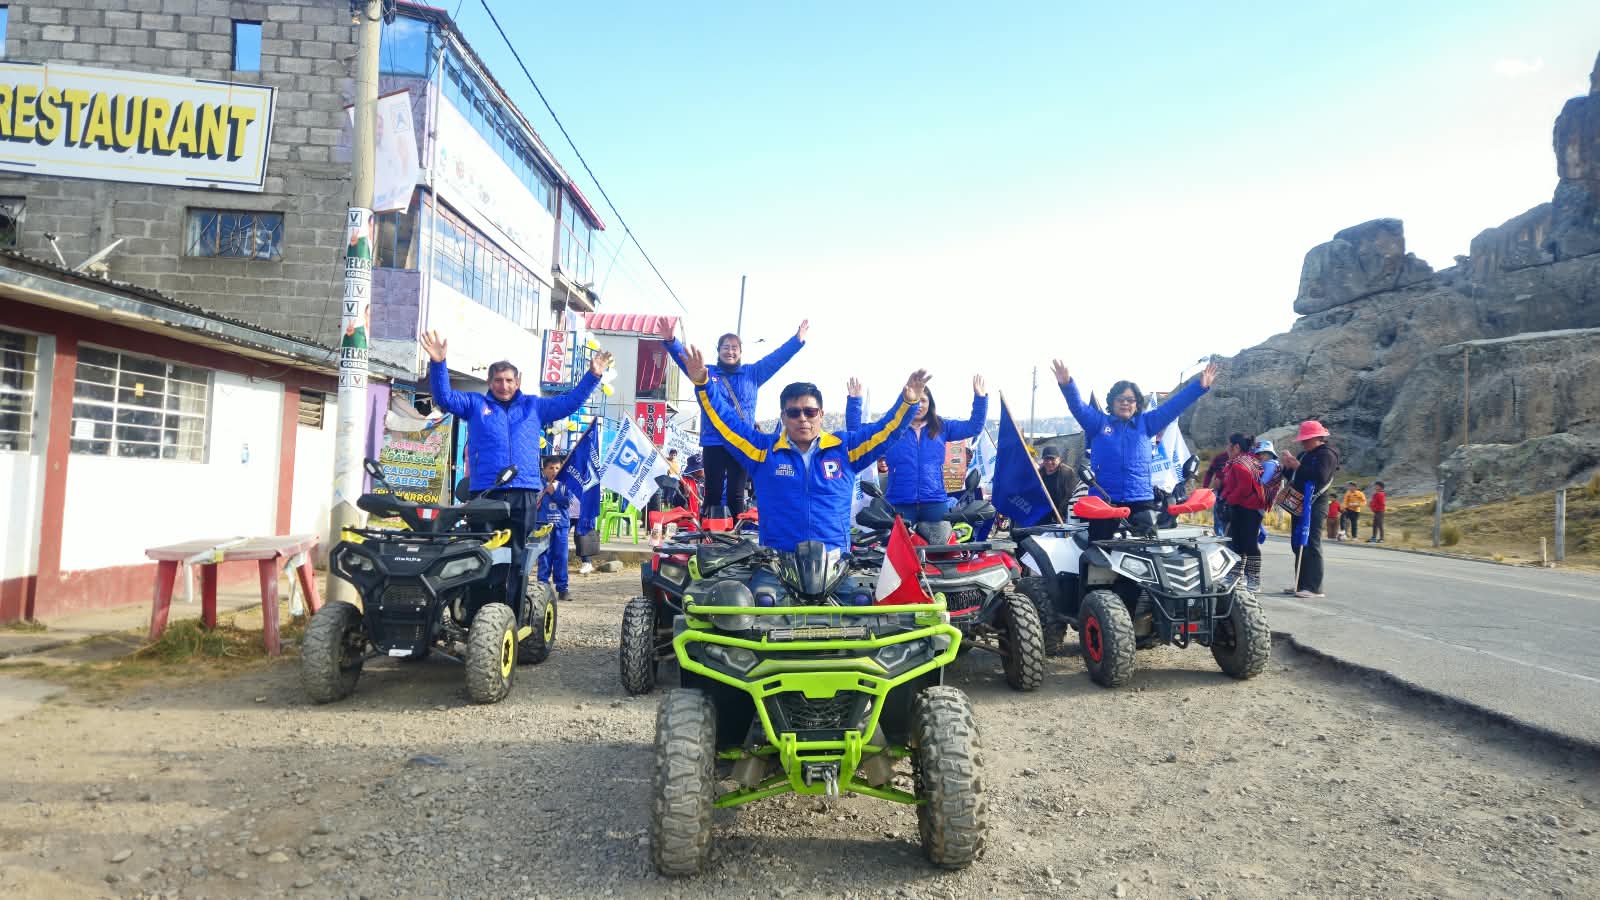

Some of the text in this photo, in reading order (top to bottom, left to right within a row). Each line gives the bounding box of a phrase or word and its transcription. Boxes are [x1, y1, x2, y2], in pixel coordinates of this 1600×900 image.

[0, 83, 256, 161] RESTAURANT
[546, 331, 564, 382] BAÑO
[383, 465, 437, 478] CALDO DE
[387, 475, 429, 487] CABEZA
